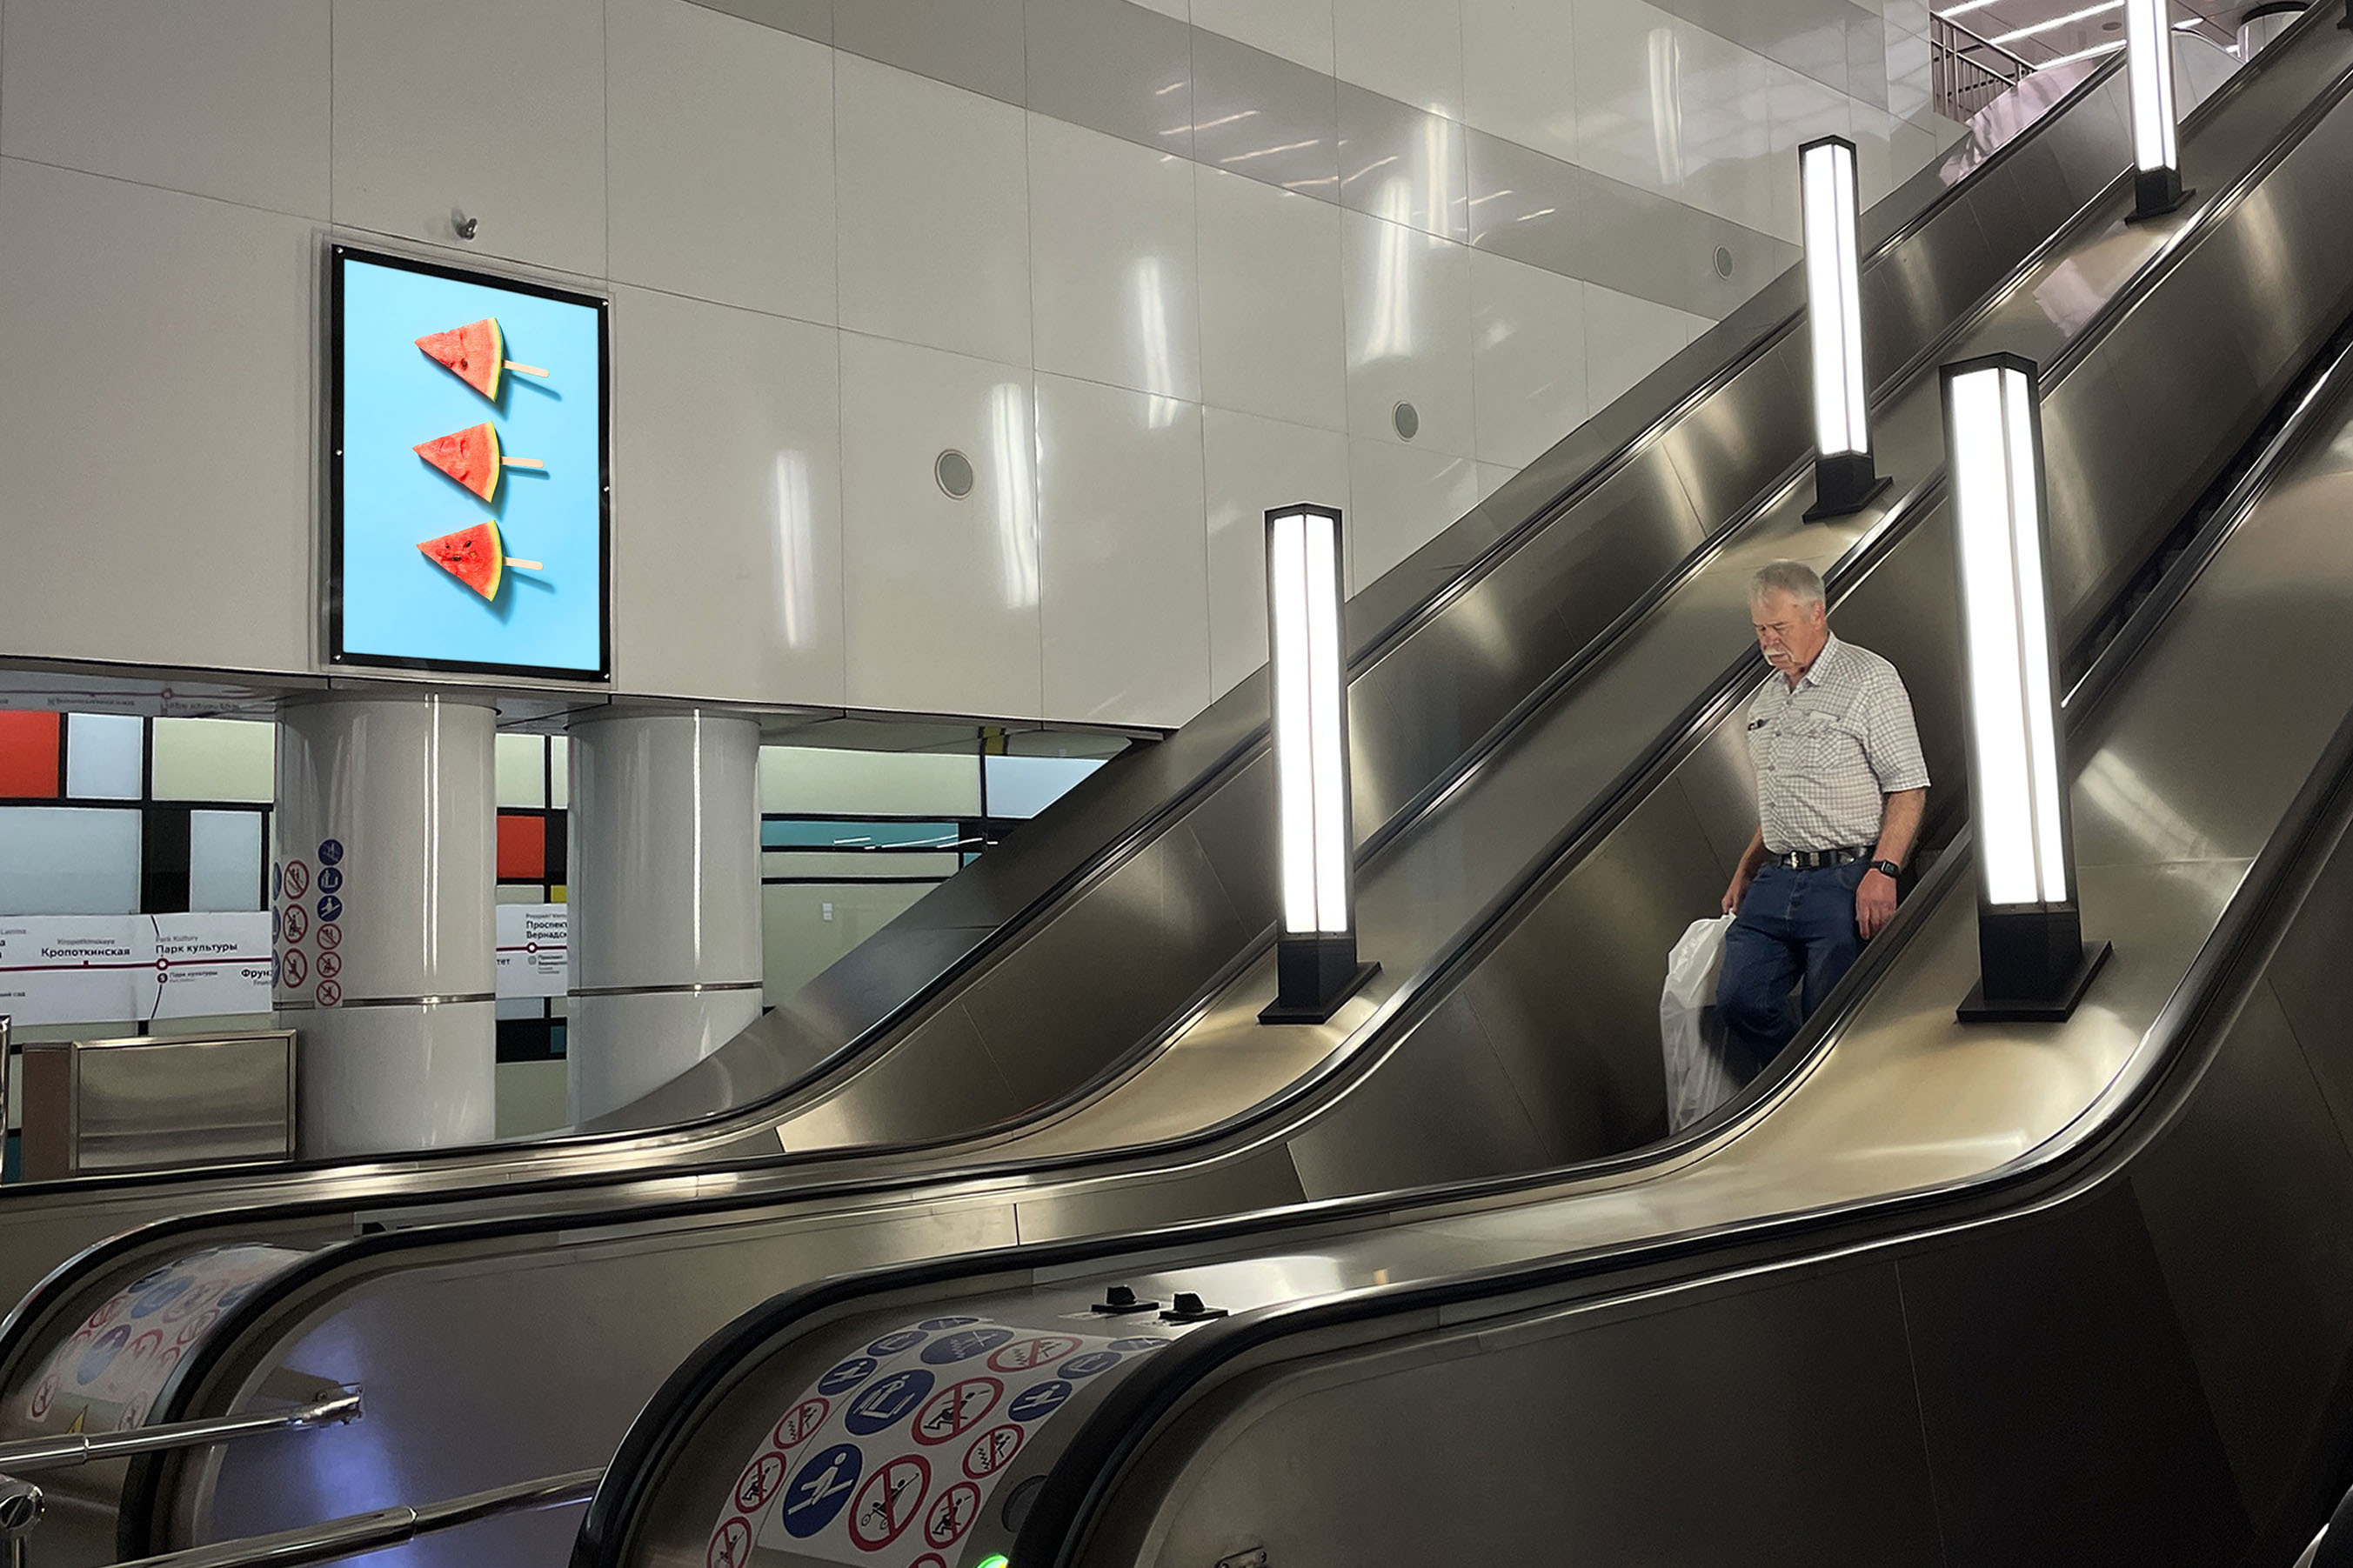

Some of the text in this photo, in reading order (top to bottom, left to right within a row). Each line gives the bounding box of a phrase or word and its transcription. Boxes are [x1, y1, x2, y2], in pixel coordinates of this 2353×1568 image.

[41, 948, 130, 958] Кропоткинская
[156, 943, 237, 955] Парк культуры
